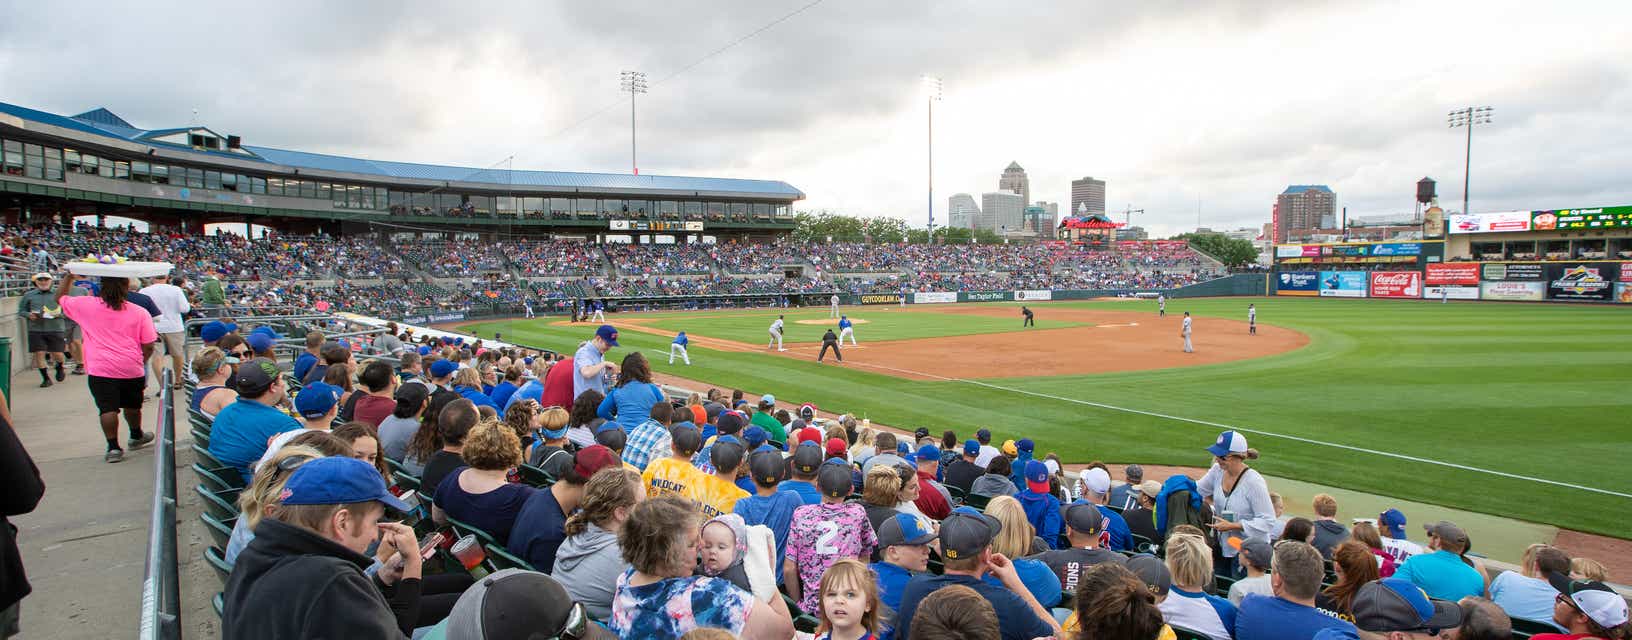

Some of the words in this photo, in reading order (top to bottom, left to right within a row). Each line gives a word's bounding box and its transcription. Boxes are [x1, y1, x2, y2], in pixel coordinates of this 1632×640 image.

[861, 294, 906, 304] GUYCOOKLAW.C
[651, 477, 686, 493] WILDCAT
[816, 520, 839, 555] 2
[1066, 561, 1080, 593] PIONS
